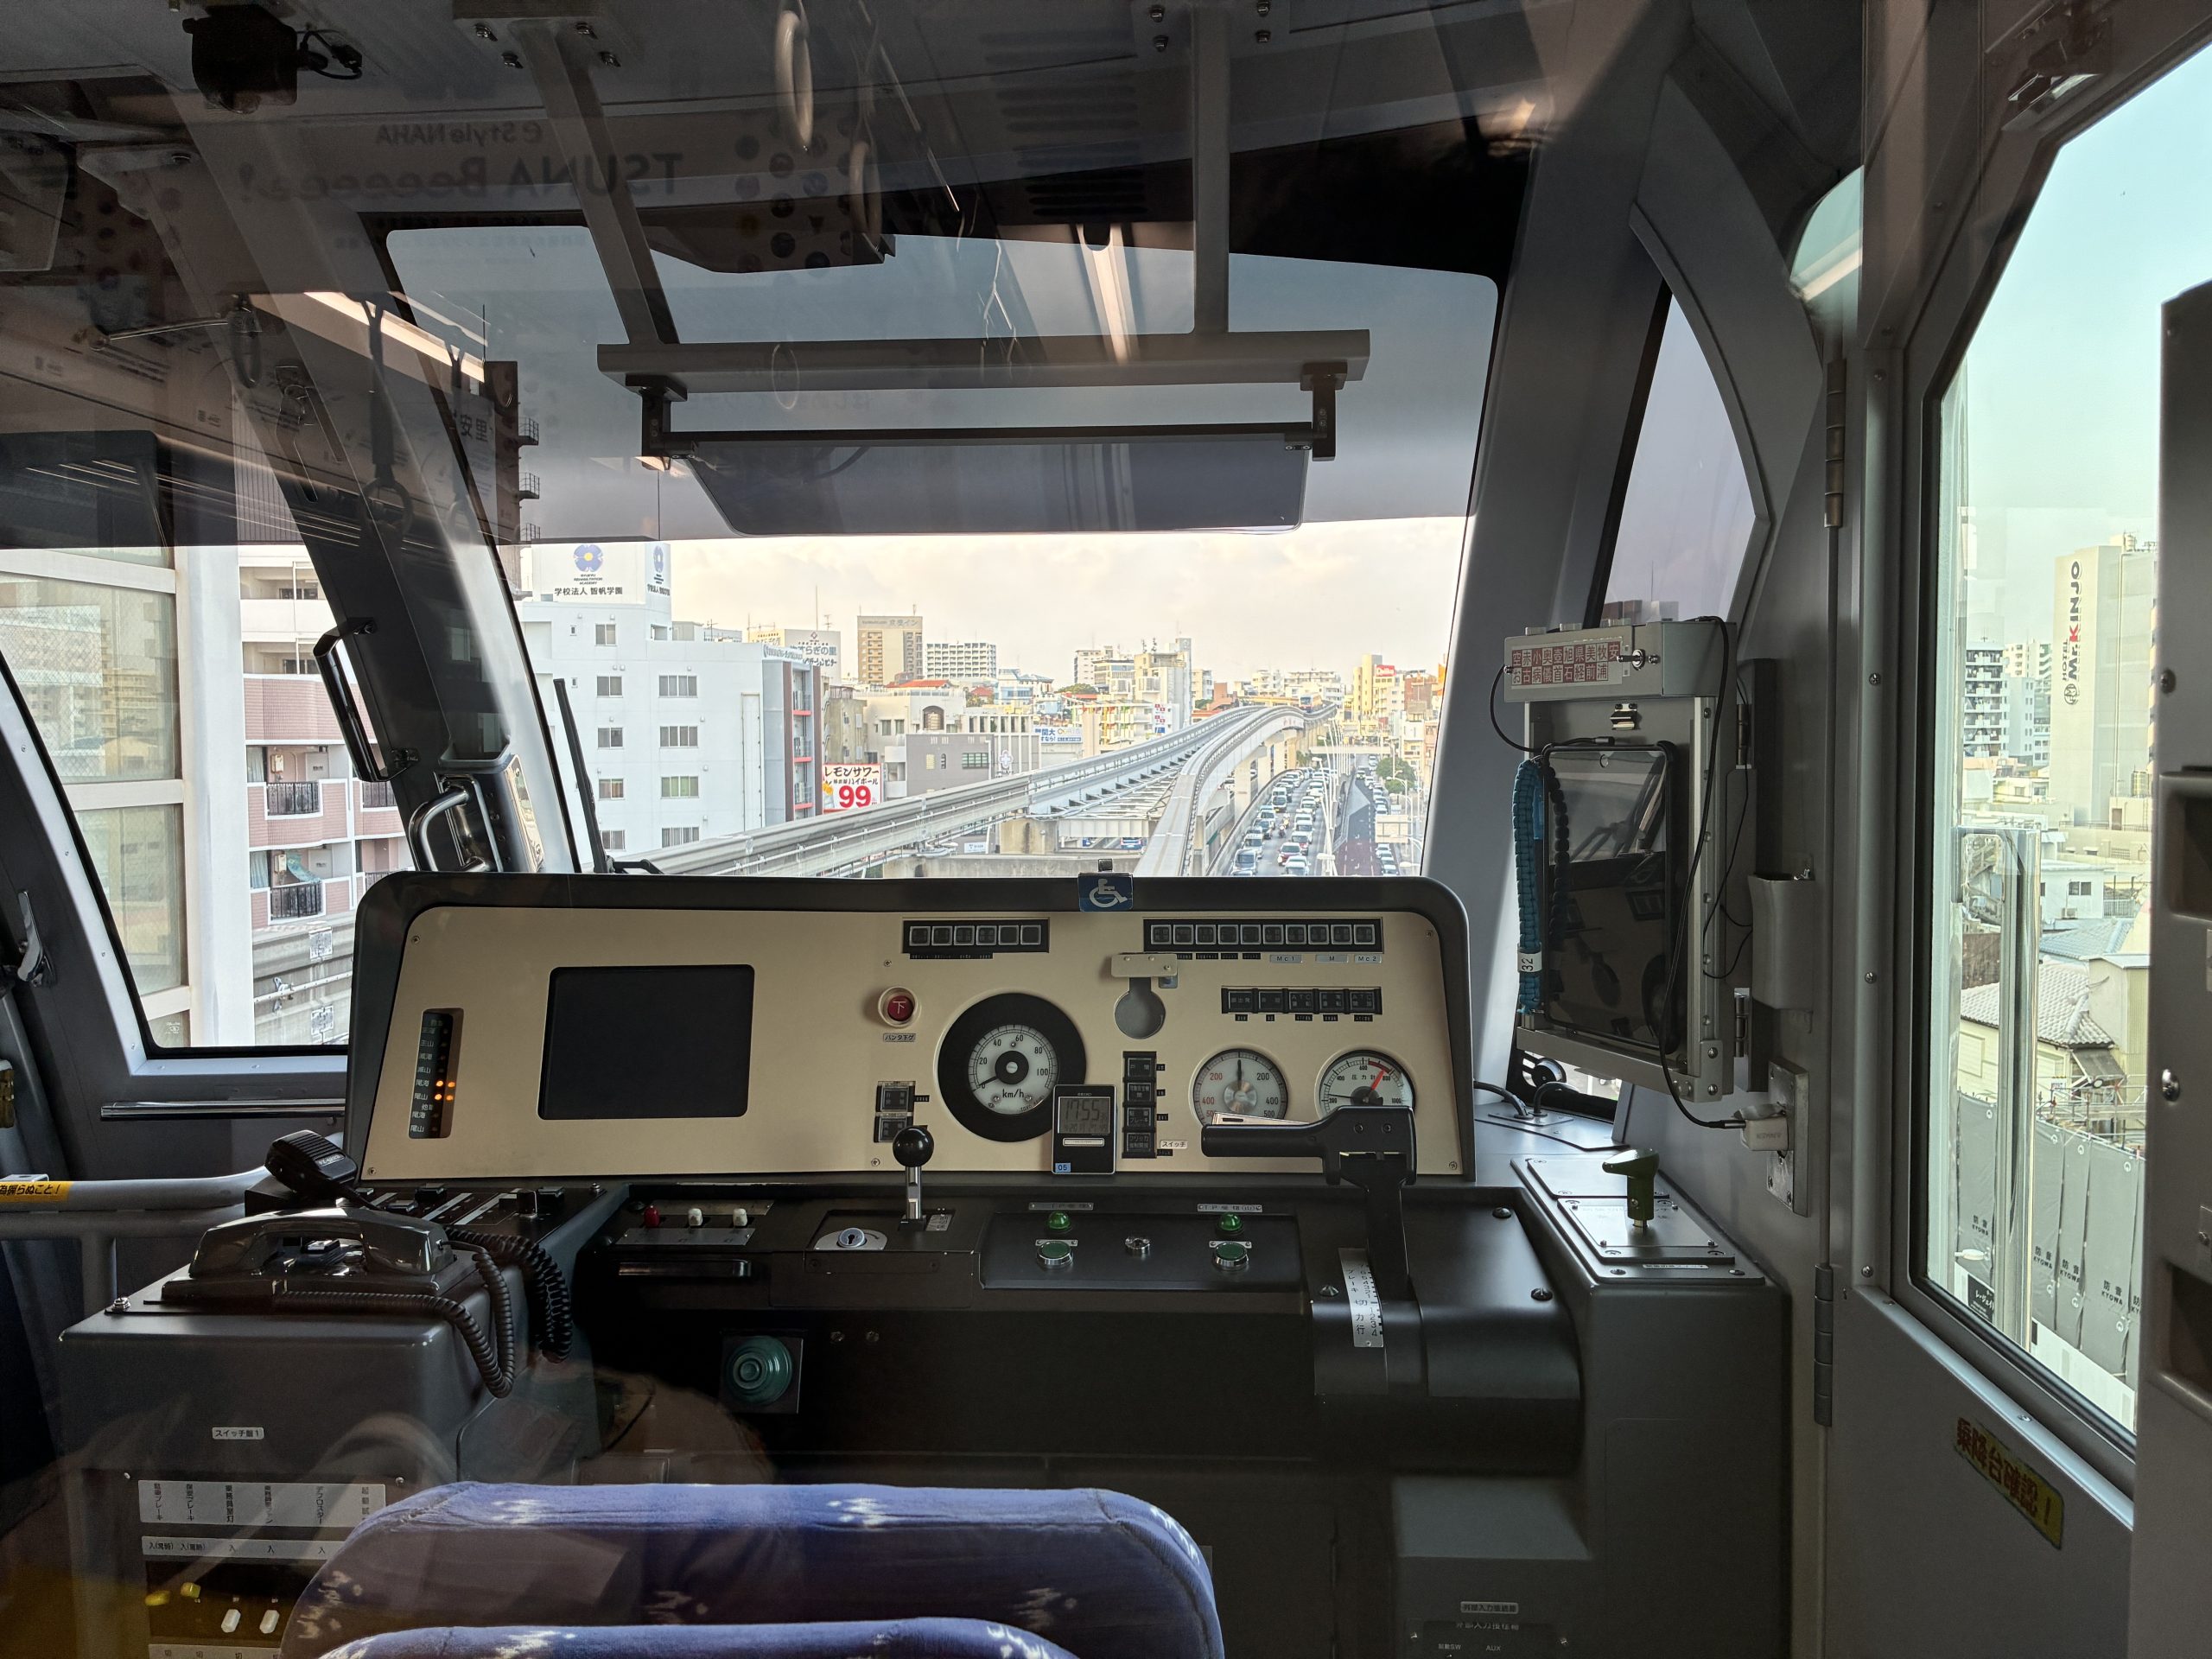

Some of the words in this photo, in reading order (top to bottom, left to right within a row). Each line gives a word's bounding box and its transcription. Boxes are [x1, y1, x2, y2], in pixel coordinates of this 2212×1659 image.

[554, 587, 588, 596] 学校法人
[824, 766, 880, 777] レモンサワー
[839, 785, 872, 809] 99
[1521, 957, 1534, 971] 32
[893, 1001, 907, 1015] 下
[979, 1057, 988, 1065] 20
[1037, 1068, 1049, 1077] 100
[1210, 1072, 1223, 1081] 200
[1256, 1072, 1270, 1081] 200
[1001, 1088, 1025, 1098] km/h
[1202, 1096, 1215, 1105] 400
[1265, 1096, 1279, 1105] 400
[1263, 1109, 1275, 1118] 500
[1971, 1224, 1989, 1236] KYOWA
[2034, 1245, 2053, 1262] 防音
[2033, 1255, 2053, 1269] KYOWA
[2062, 1258, 2079, 1274] 防音
[2059, 1268, 2081, 1283] KYOWA
[2103, 1280, 2123, 1296] 防音
[2101, 1290, 2123, 1306] KYOWA
[1356, 1313, 1365, 1335] 力行
[229, 1544, 237, 1553] 入
[267, 1545, 275, 1554] 入
